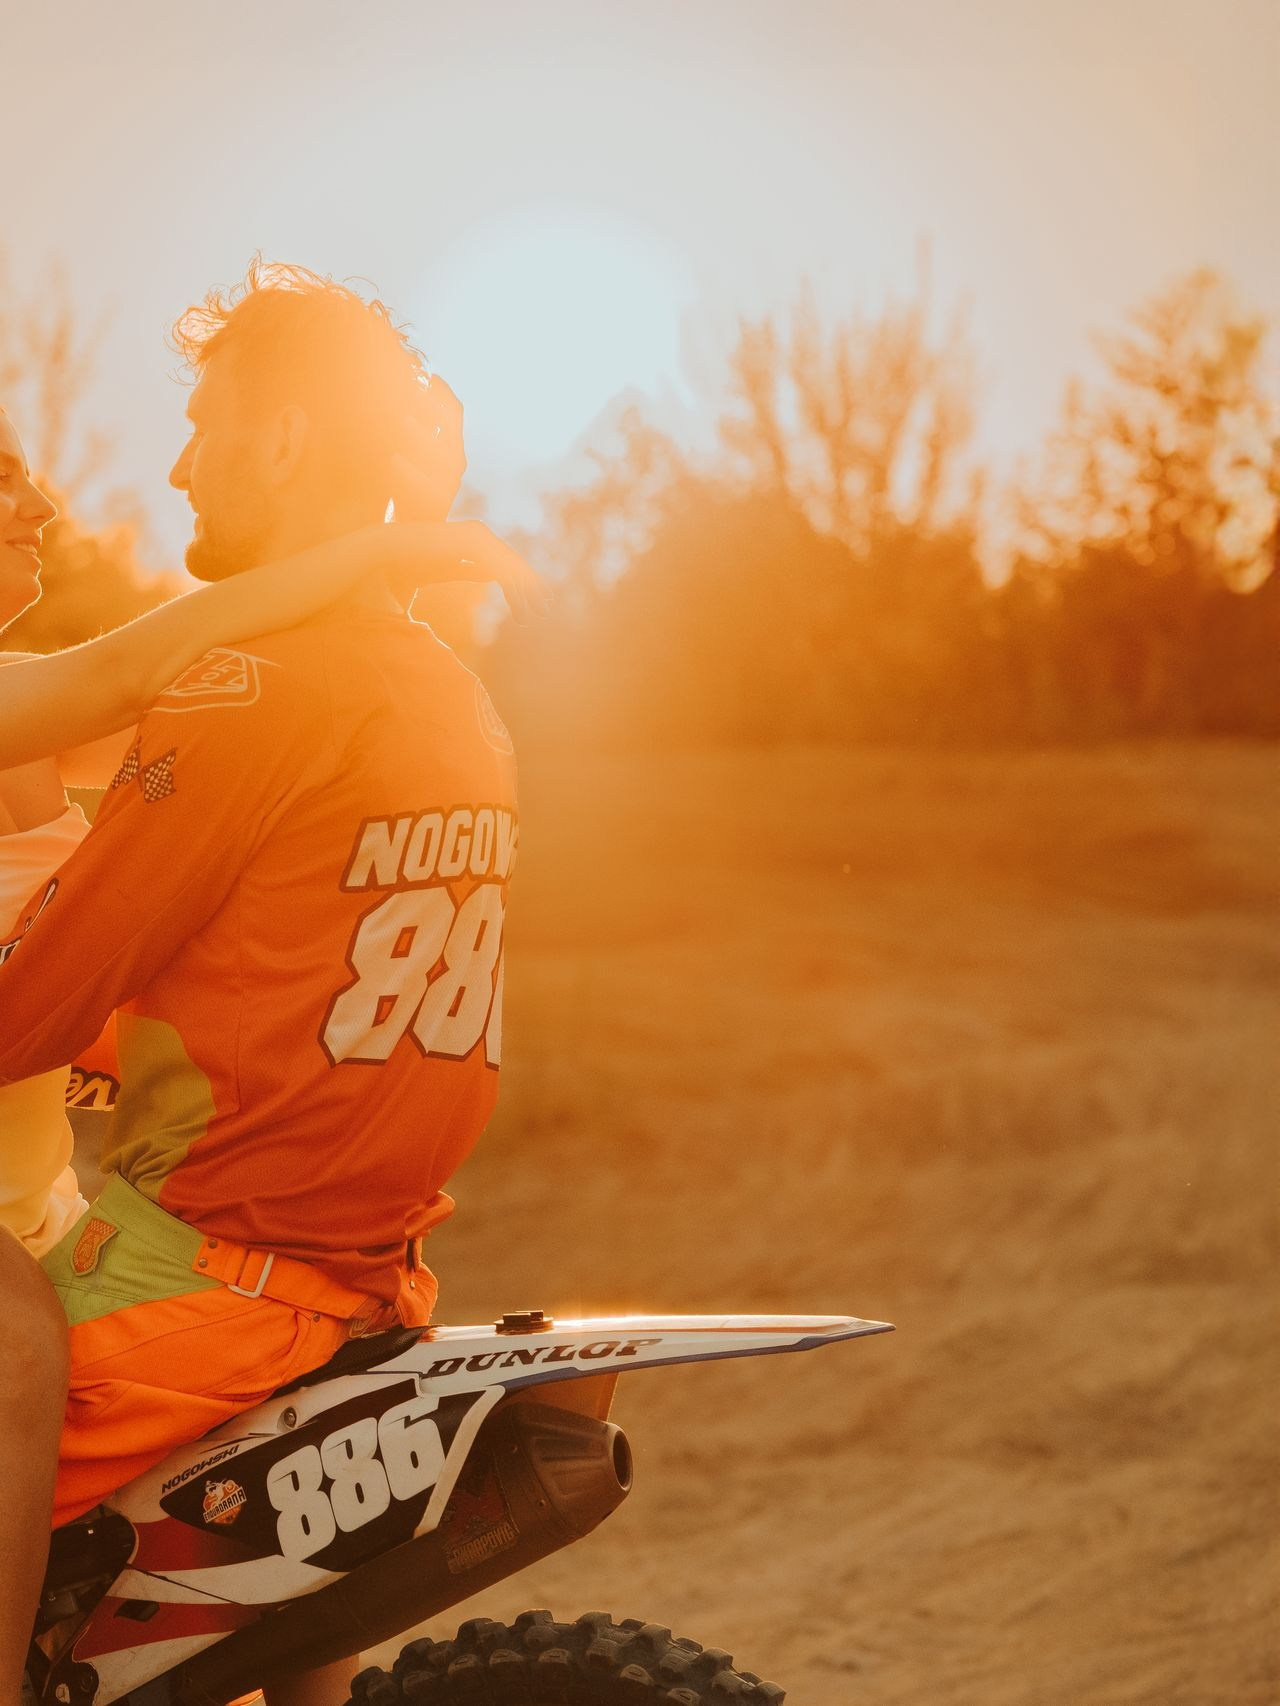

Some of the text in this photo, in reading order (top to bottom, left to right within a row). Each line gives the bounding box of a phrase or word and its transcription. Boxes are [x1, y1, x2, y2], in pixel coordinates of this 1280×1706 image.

[322, 883, 506, 1065] 88
[421, 1338, 663, 1380] DUNLOP
[161, 1444, 240, 1494] NOGOWSKI
[267, 1399, 446, 1563] 886
